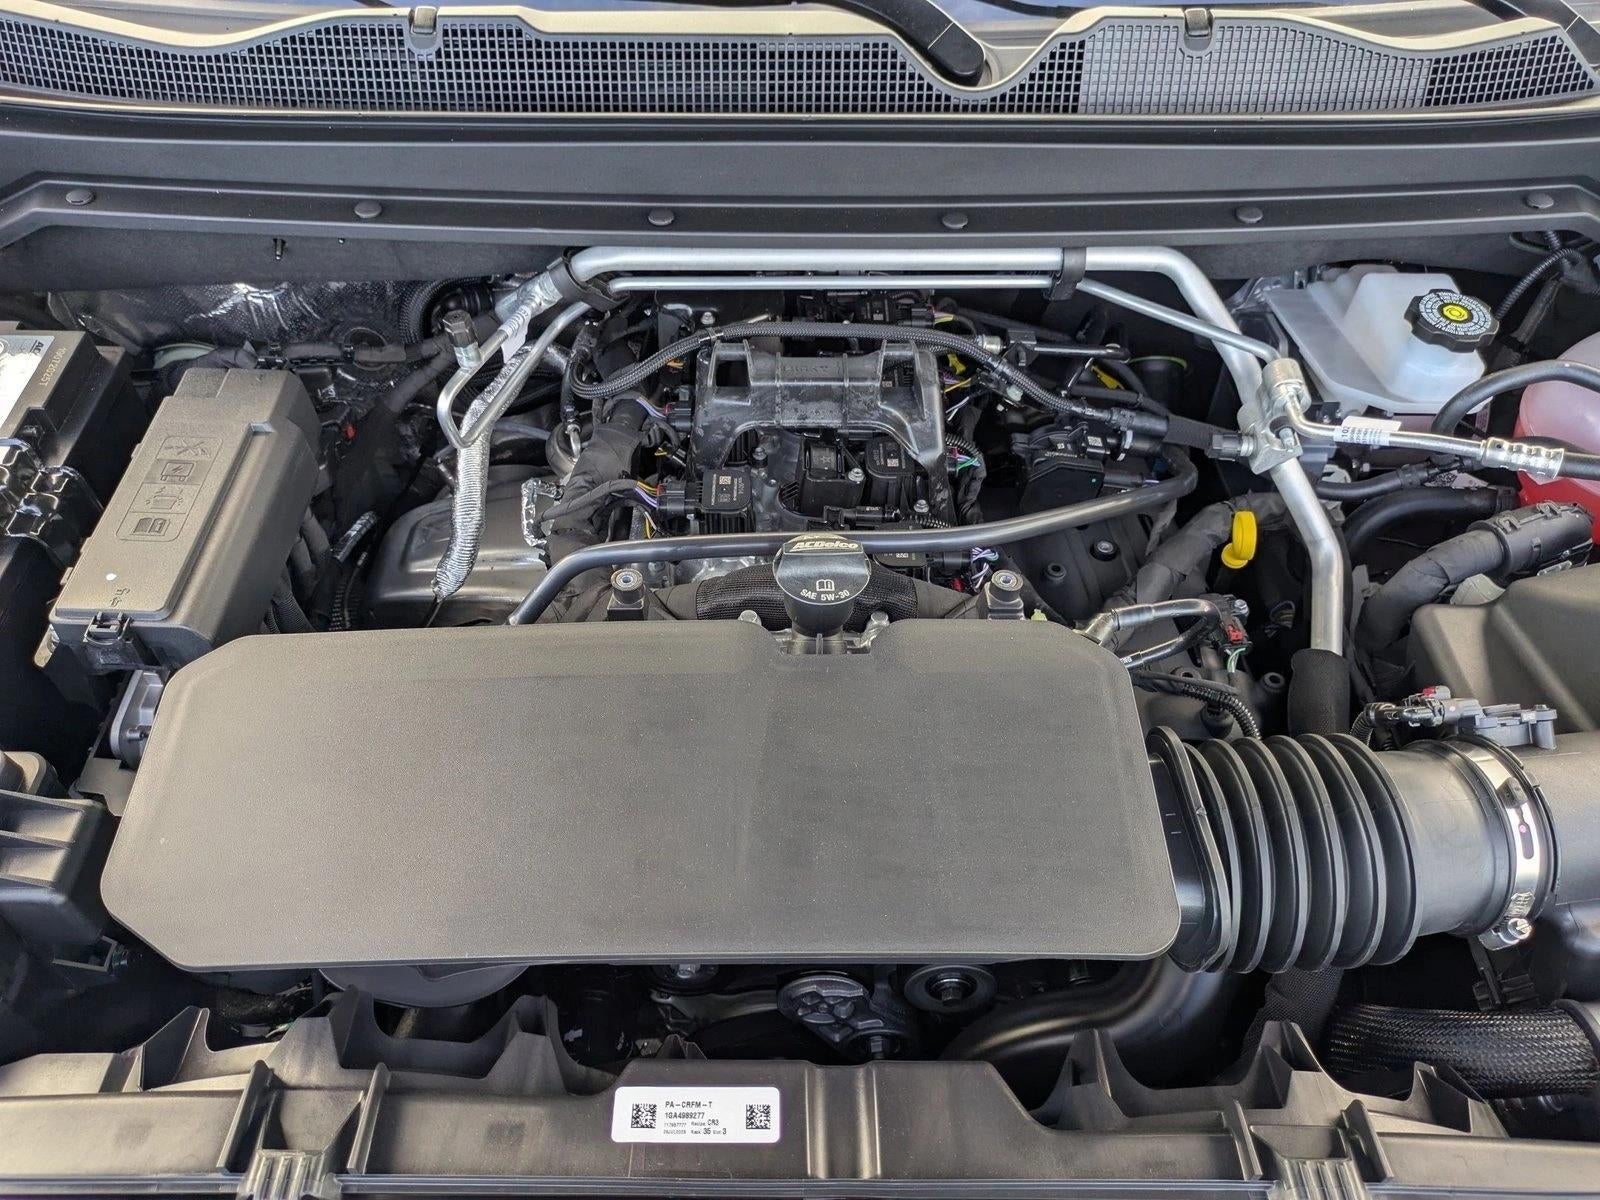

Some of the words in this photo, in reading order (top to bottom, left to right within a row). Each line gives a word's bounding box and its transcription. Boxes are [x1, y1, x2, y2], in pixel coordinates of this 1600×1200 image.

[791, 540, 859, 551] ACDelco
[800, 588, 817, 600] SAE
[821, 589, 850, 601] 5W-30
[703, 1127, 711, 1135] 35
[722, 1127, 727, 1135] 3
